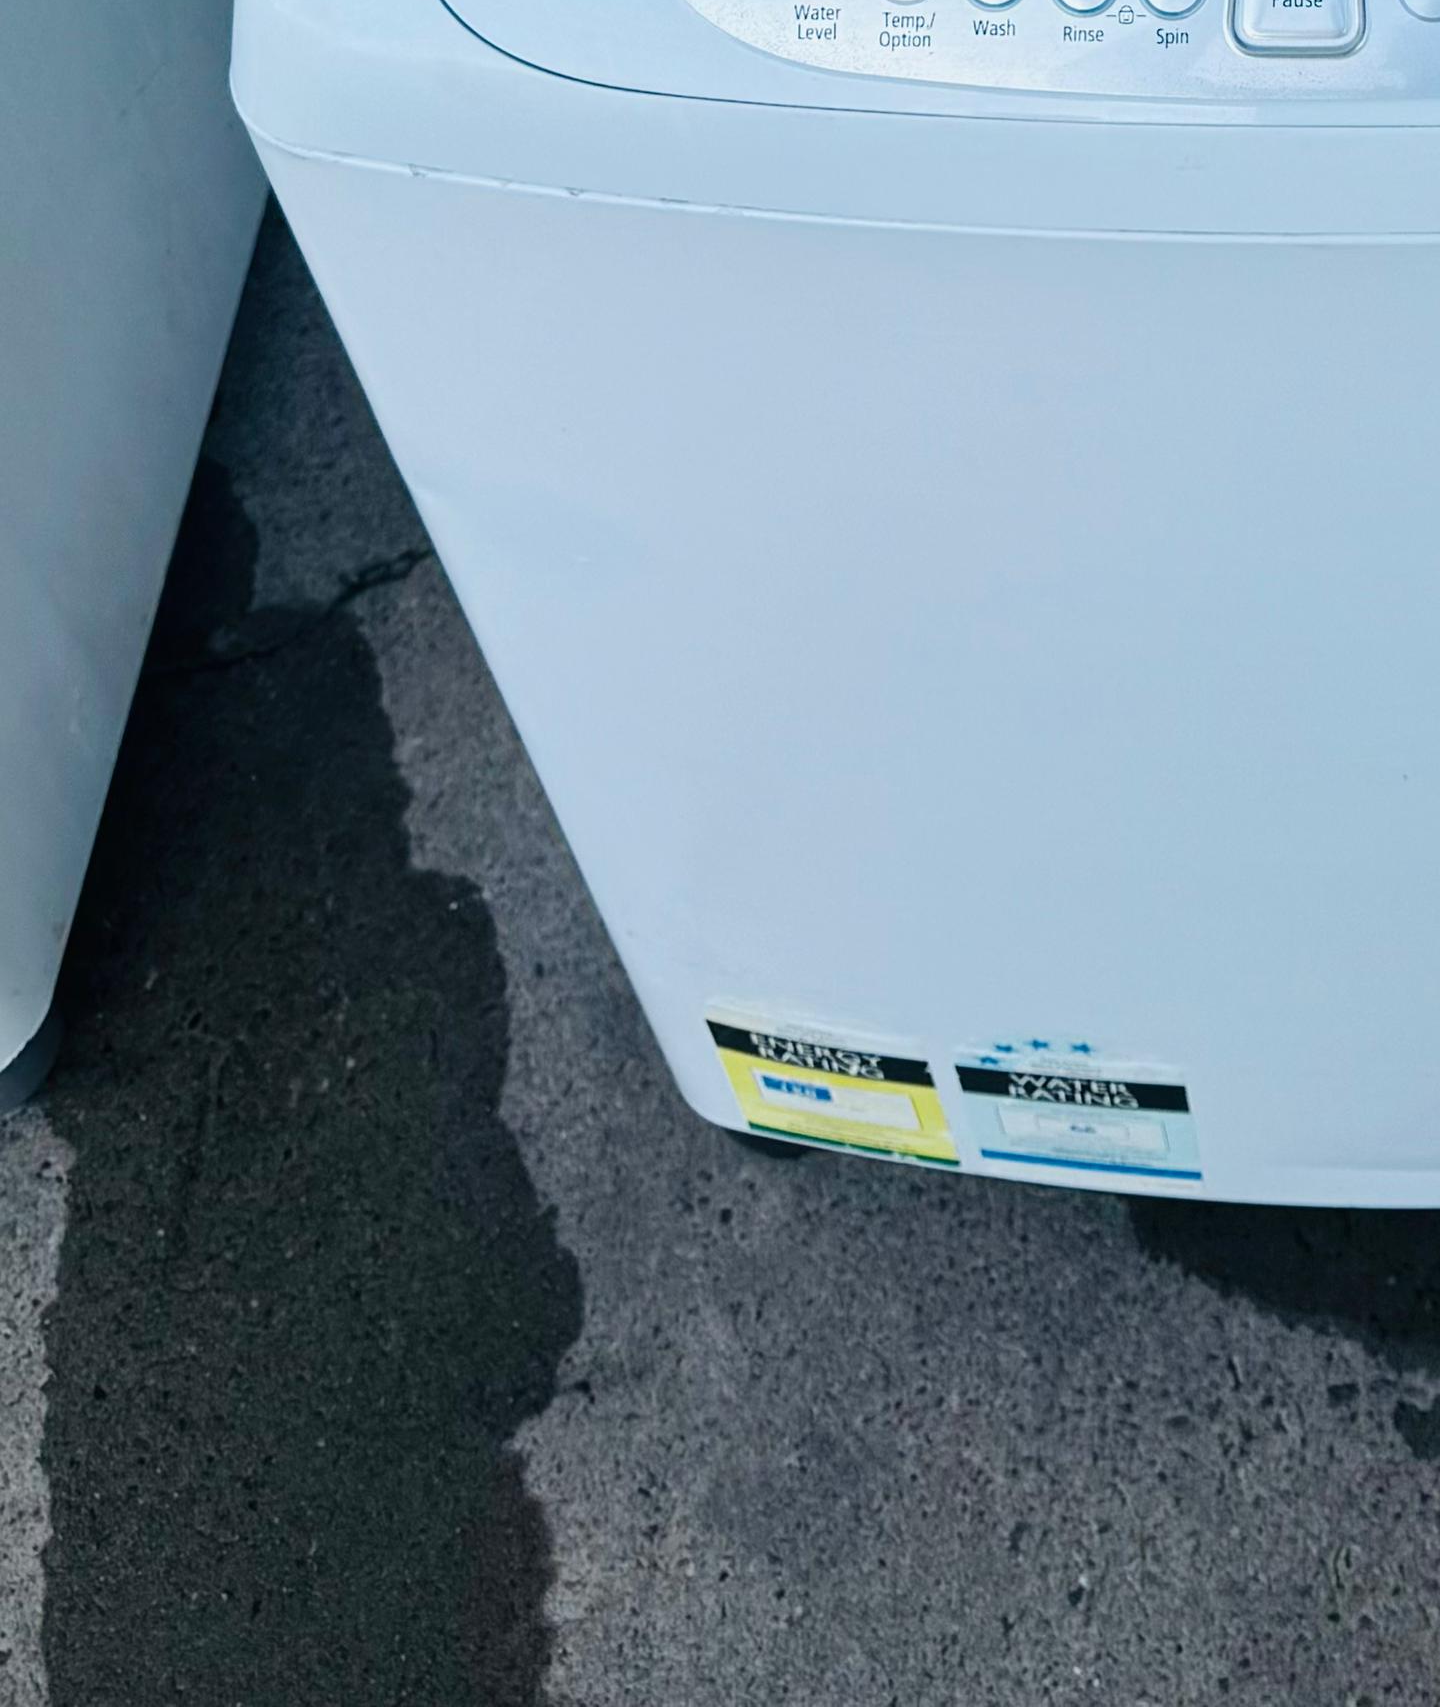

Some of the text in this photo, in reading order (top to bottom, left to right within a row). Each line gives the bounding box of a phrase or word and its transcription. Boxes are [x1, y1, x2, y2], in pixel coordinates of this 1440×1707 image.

[793, 4, 842, 25] Water
[880, 11, 936, 35] Temp./
[797, 22, 837, 41] Level
[972, 18, 1016, 37] Wash
[1063, 25, 1105, 43] Rinse
[1156, 27, 1189, 50] Spin
[878, 27, 932, 52] Option
[750, 1033, 882, 1070] ENERGY
[1008, 1072, 1132, 1096] WATER
[1008, 1083, 1140, 1109] RATING
